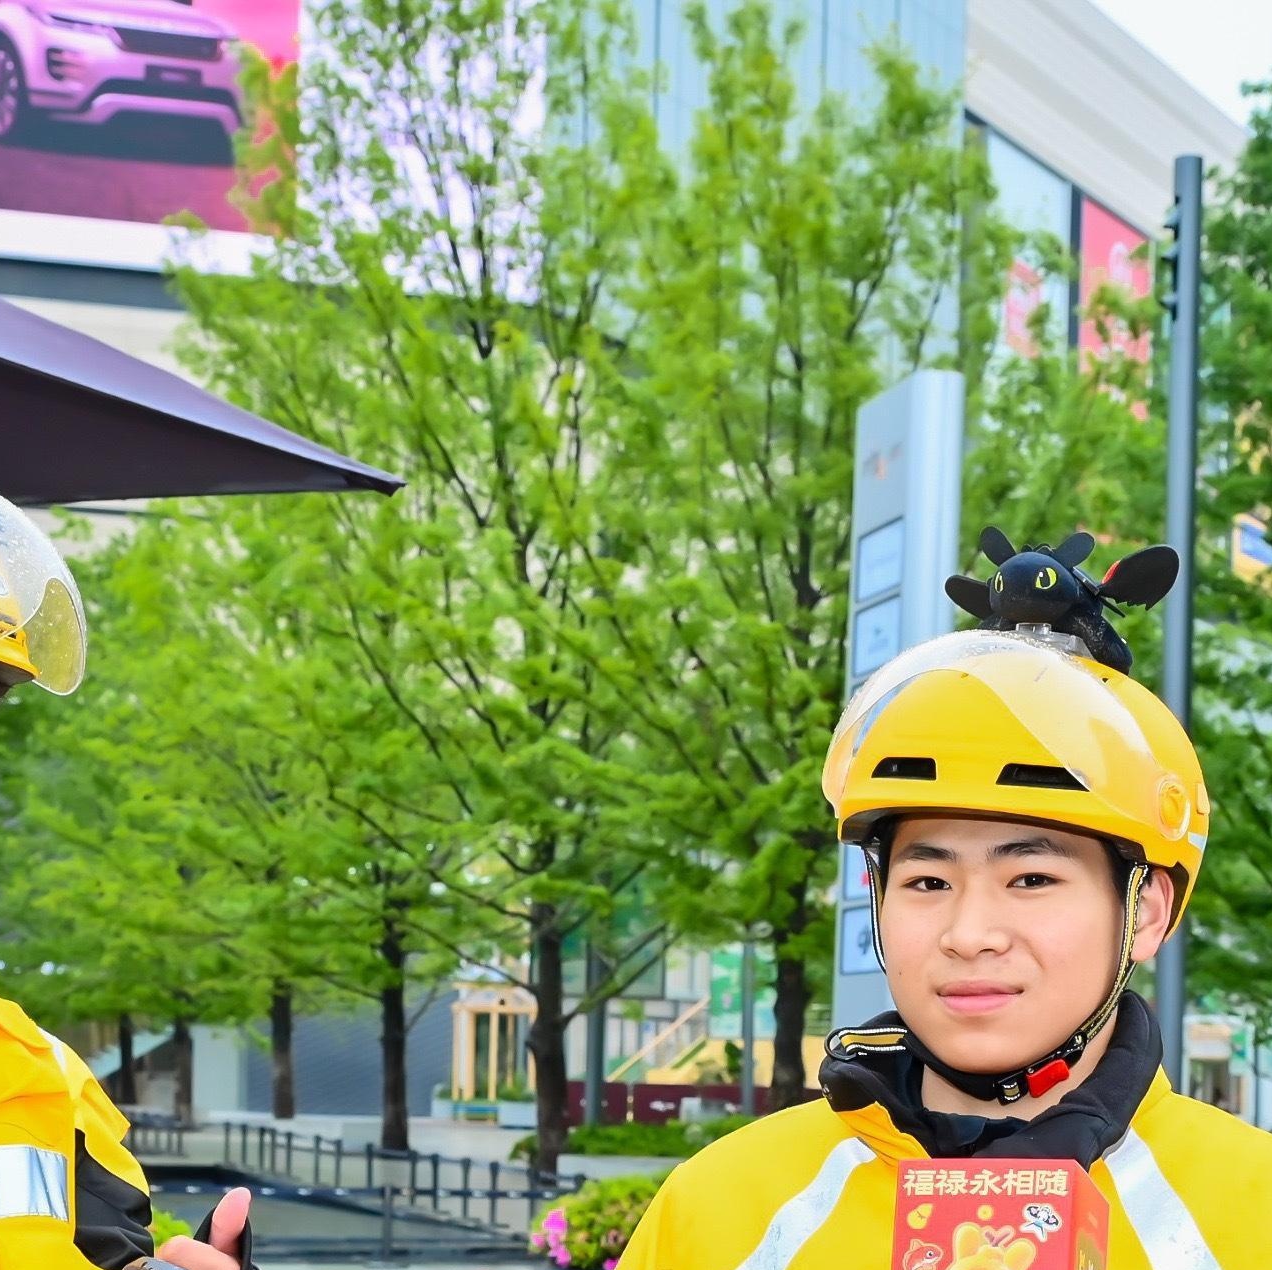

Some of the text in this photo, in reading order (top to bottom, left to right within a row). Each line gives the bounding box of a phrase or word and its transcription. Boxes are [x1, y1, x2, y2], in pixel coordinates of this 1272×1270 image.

[903, 1168, 1070, 1197] 福禄永相随
